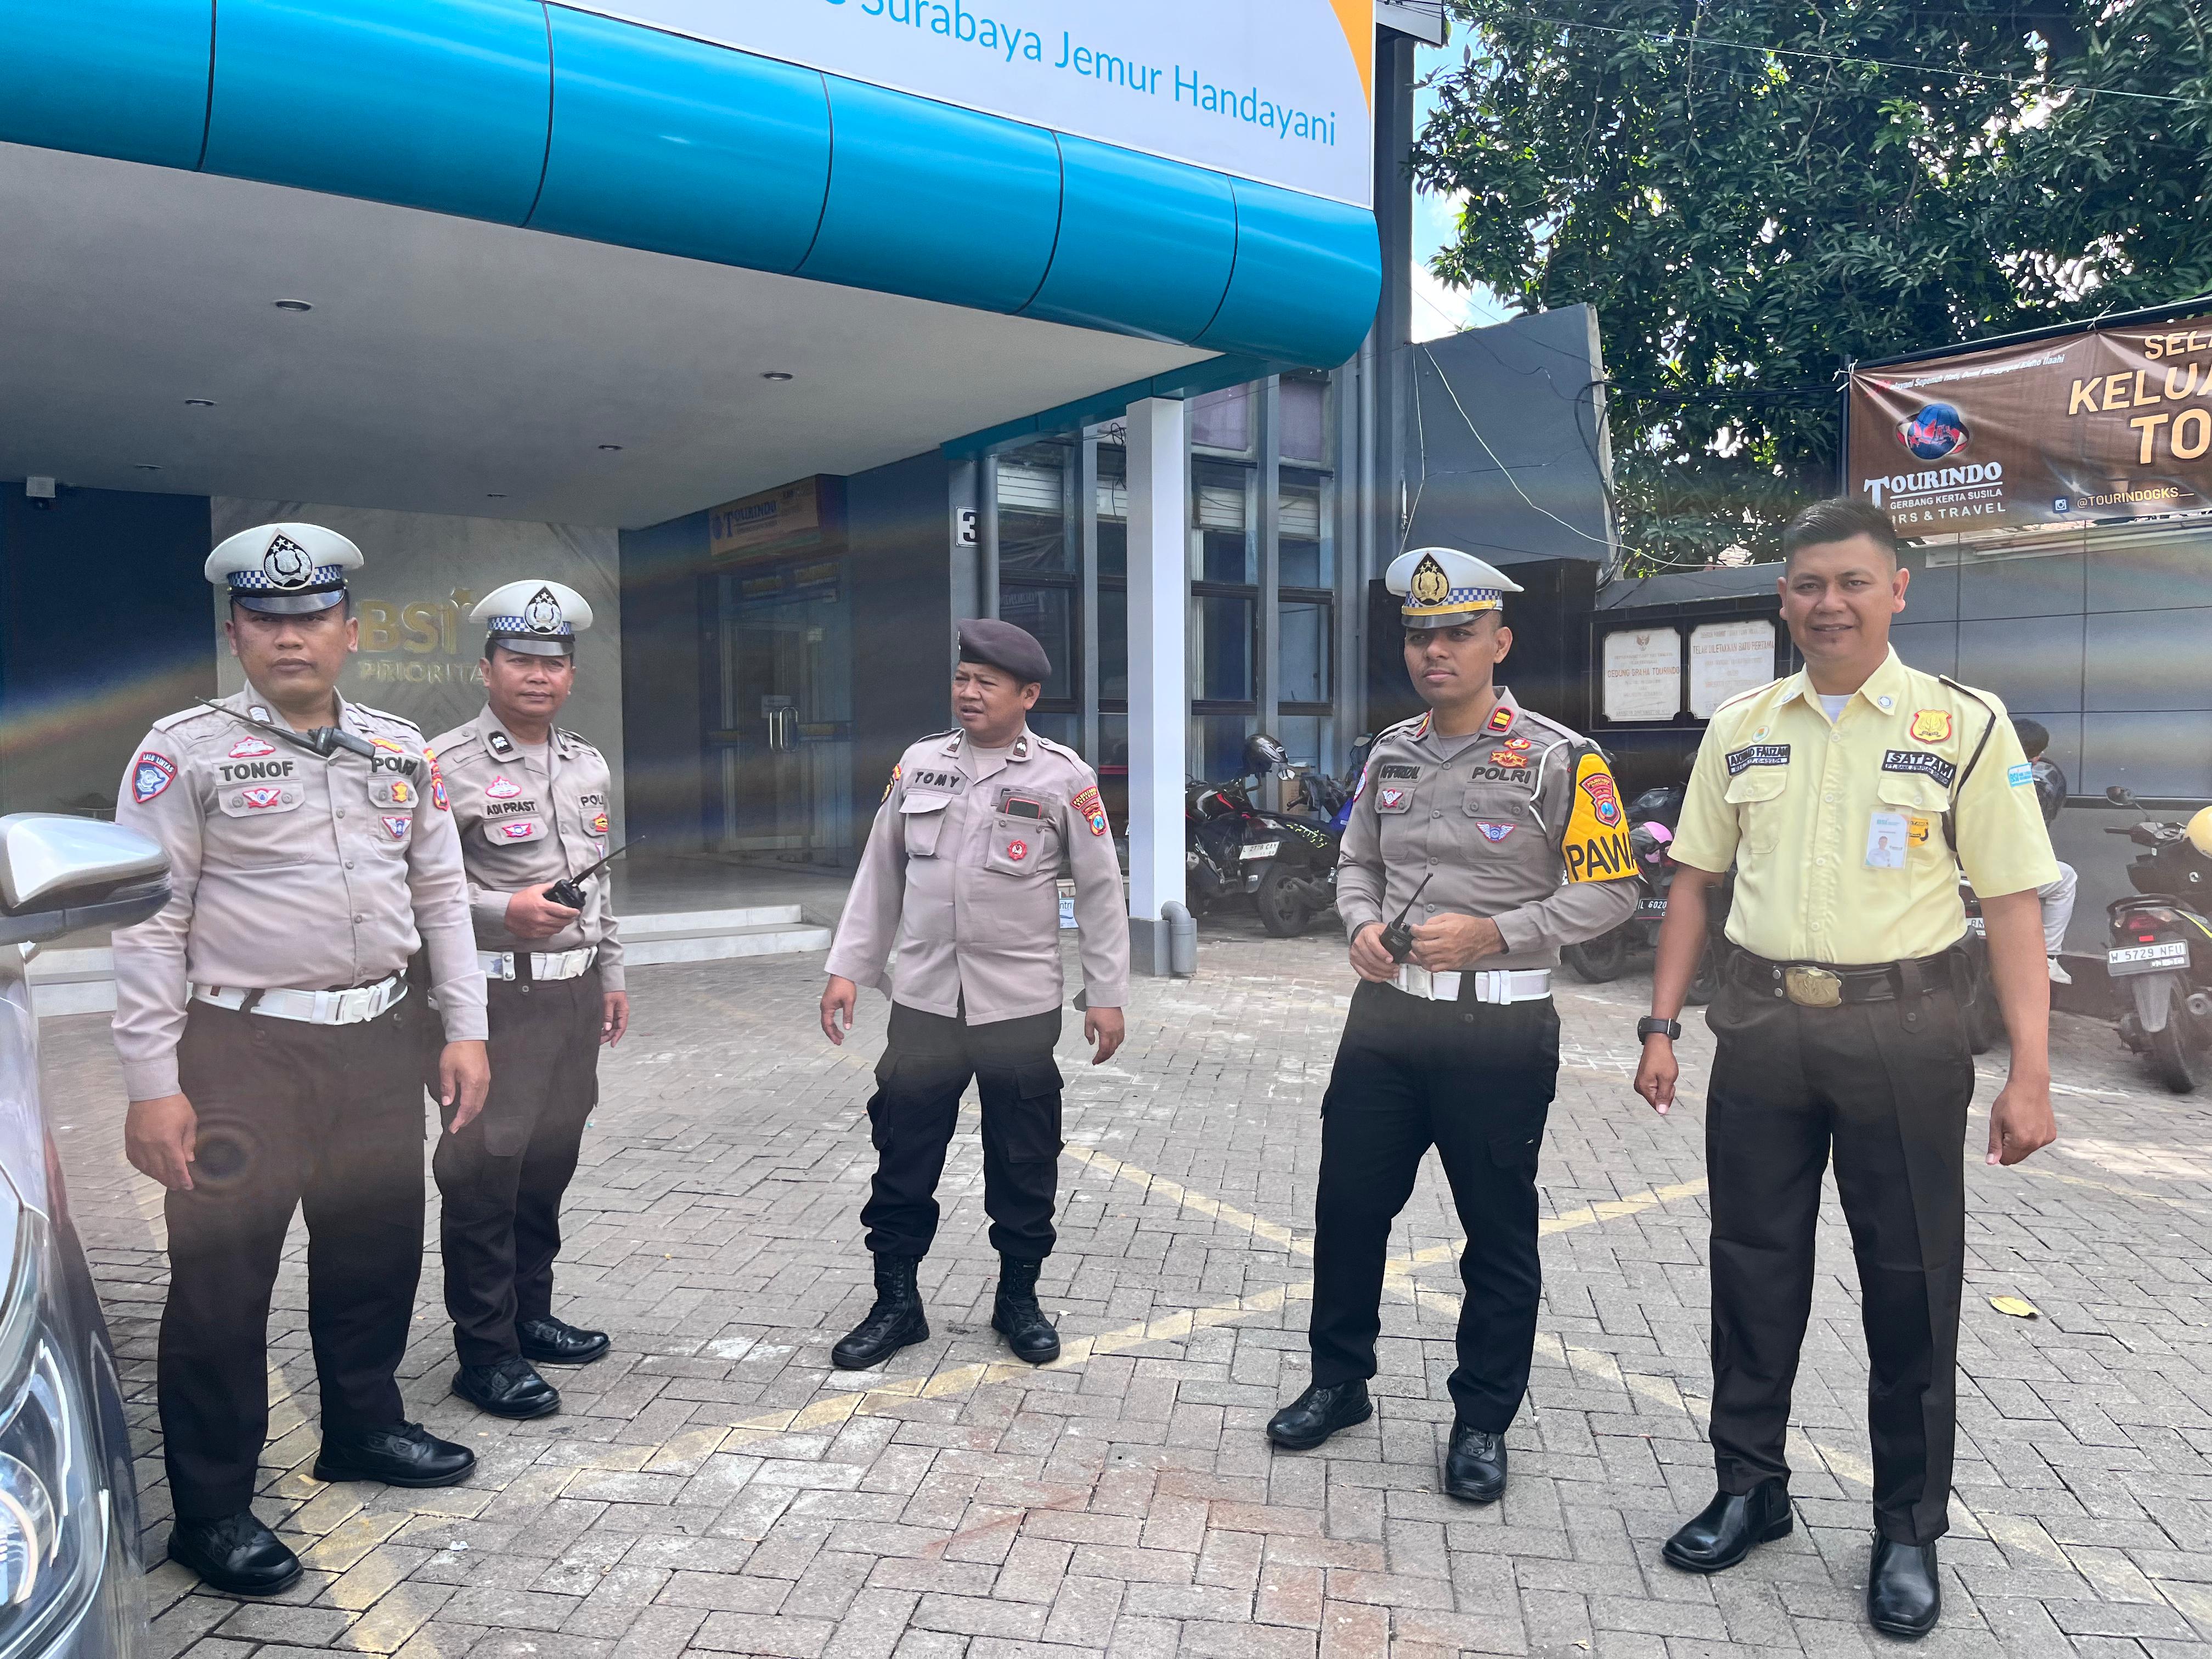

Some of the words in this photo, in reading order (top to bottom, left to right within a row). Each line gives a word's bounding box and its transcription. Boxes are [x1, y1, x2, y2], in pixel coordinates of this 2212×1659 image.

[1054, 31, 1163, 95] Jemur
[1174, 64, 1335, 146] Handayani
[2144, 330, 2212, 360] SEL
[2130, 408, 2211, 464] TO
[1863, 461, 2002, 510] TOURINDO
[1890, 497, 1934, 510] GERBANG
[1936, 493, 1966, 504] KERTA
[1968, 488, 2003, 500] SUSILA
[1923, 510, 1933, 521] &
[1938, 502, 2006, 519] TRAVEL
[360, 600, 458, 654] BSI
[358, 660, 483, 684] PRIORITA
[219, 760, 294, 781] TONOF
[1471, 766, 1531, 784] POLRI
[1889, 753, 1954, 779] SATPAM
[915, 771, 960, 788] TOMY
[487, 804, 503, 816] ADI
[504, 801, 536, 813] PRAST
[1640, 901, 1644, 909] L
[1648, 900, 1667, 909] 6020
[2111, 952, 2118, 962] W
[2125, 949, 2154, 960] 5729
[2160, 945, 2182, 956] NFU
